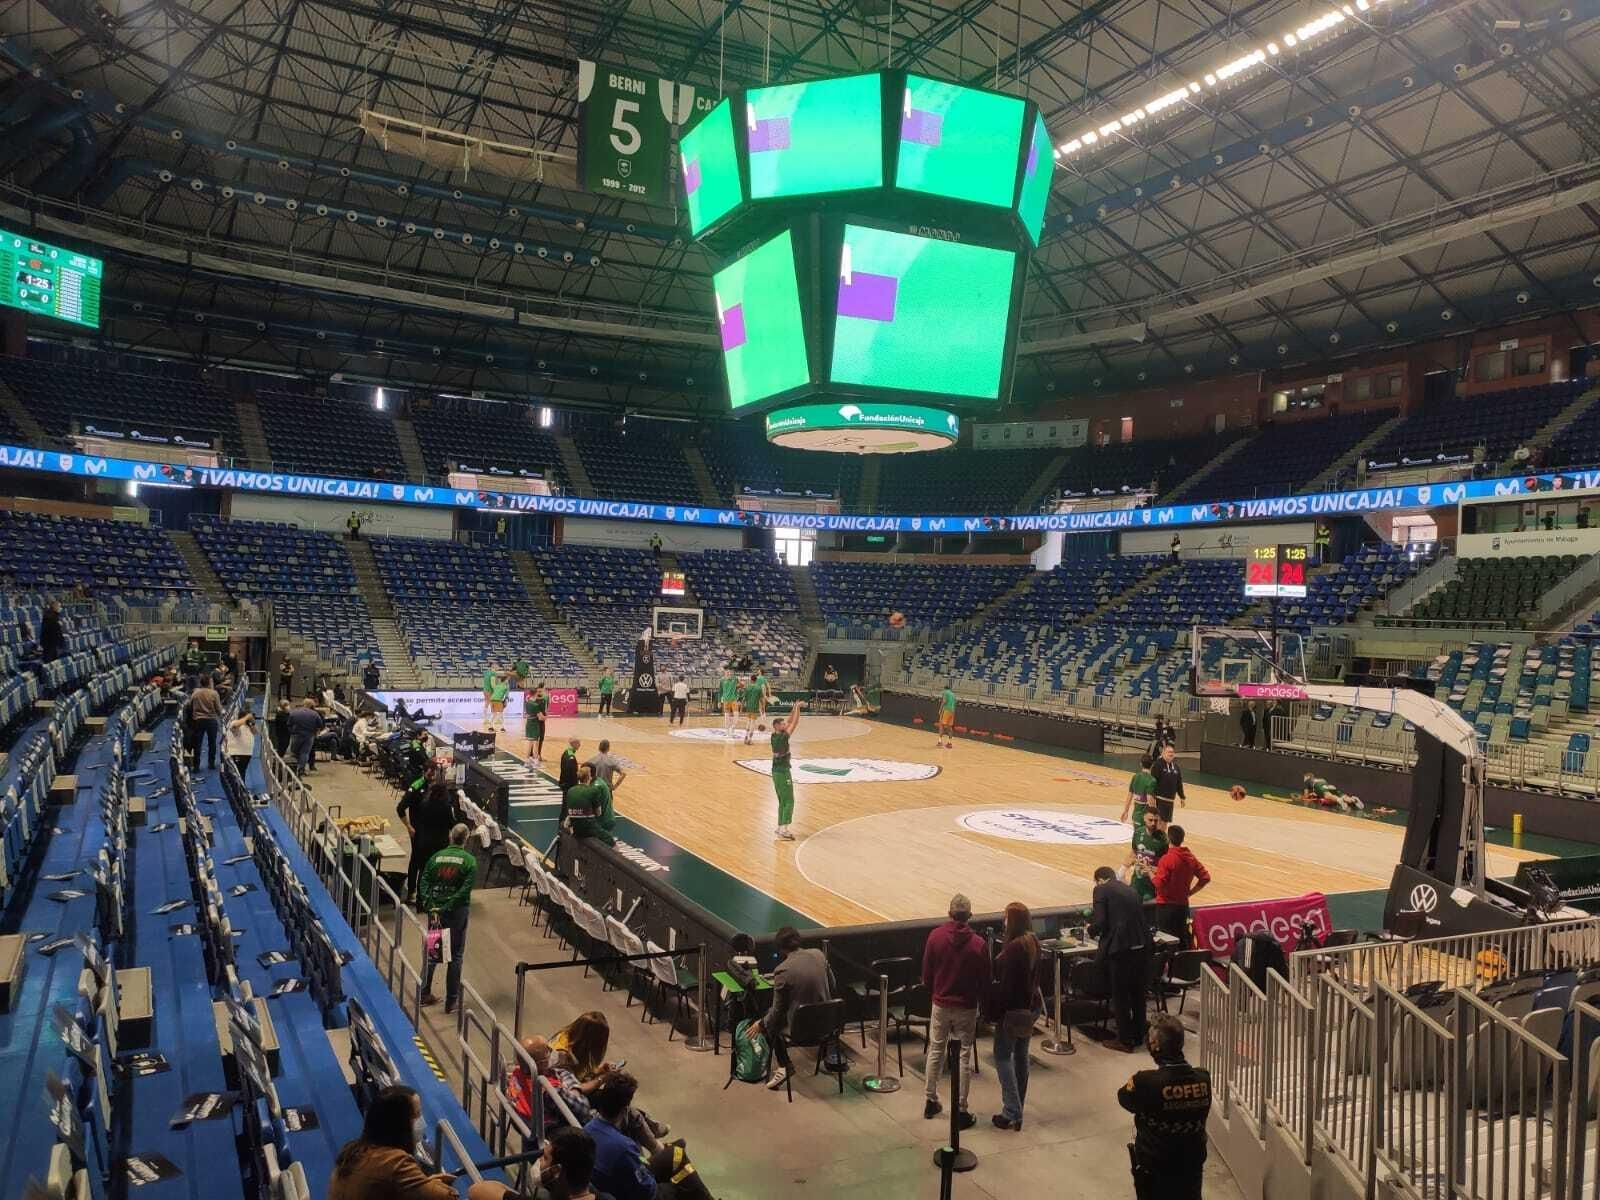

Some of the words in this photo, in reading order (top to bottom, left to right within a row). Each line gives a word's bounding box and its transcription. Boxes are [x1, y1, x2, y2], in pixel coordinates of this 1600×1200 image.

[609, 73, 646, 95] BERNI
[696, 96, 717, 111] CA
[609, 98, 642, 155] 5
[628, 183, 646, 194] 2012
[26, 275, 49, 289] 1:25
[200, 470, 285, 491] ¡VAMOS
[287, 477, 380, 498] UNICAJA!
[509, 498, 577, 513] ¡VAMOS
[579, 501, 655, 519] UNICAJA!
[765, 513, 827, 529] ¡VAMOS
[828, 516, 901, 530] UNICAJA!
[1010, 515, 1067, 531] ¡VAMOS
[1070, 511, 1133, 528] UNICAJA!
[1239, 497, 1308, 518] ¡VAMOS
[1311, 489, 1403, 512] UNICAJA!
[1254, 547, 1276, 559] 1:25
[1285, 548, 1306, 560] 1:25
[1248, 562, 1274, 584] 24
[1281, 561, 1305, 584] 24
[1257, 686, 1300, 698] endesa
[1162, 1082, 1208, 1100] COFER
